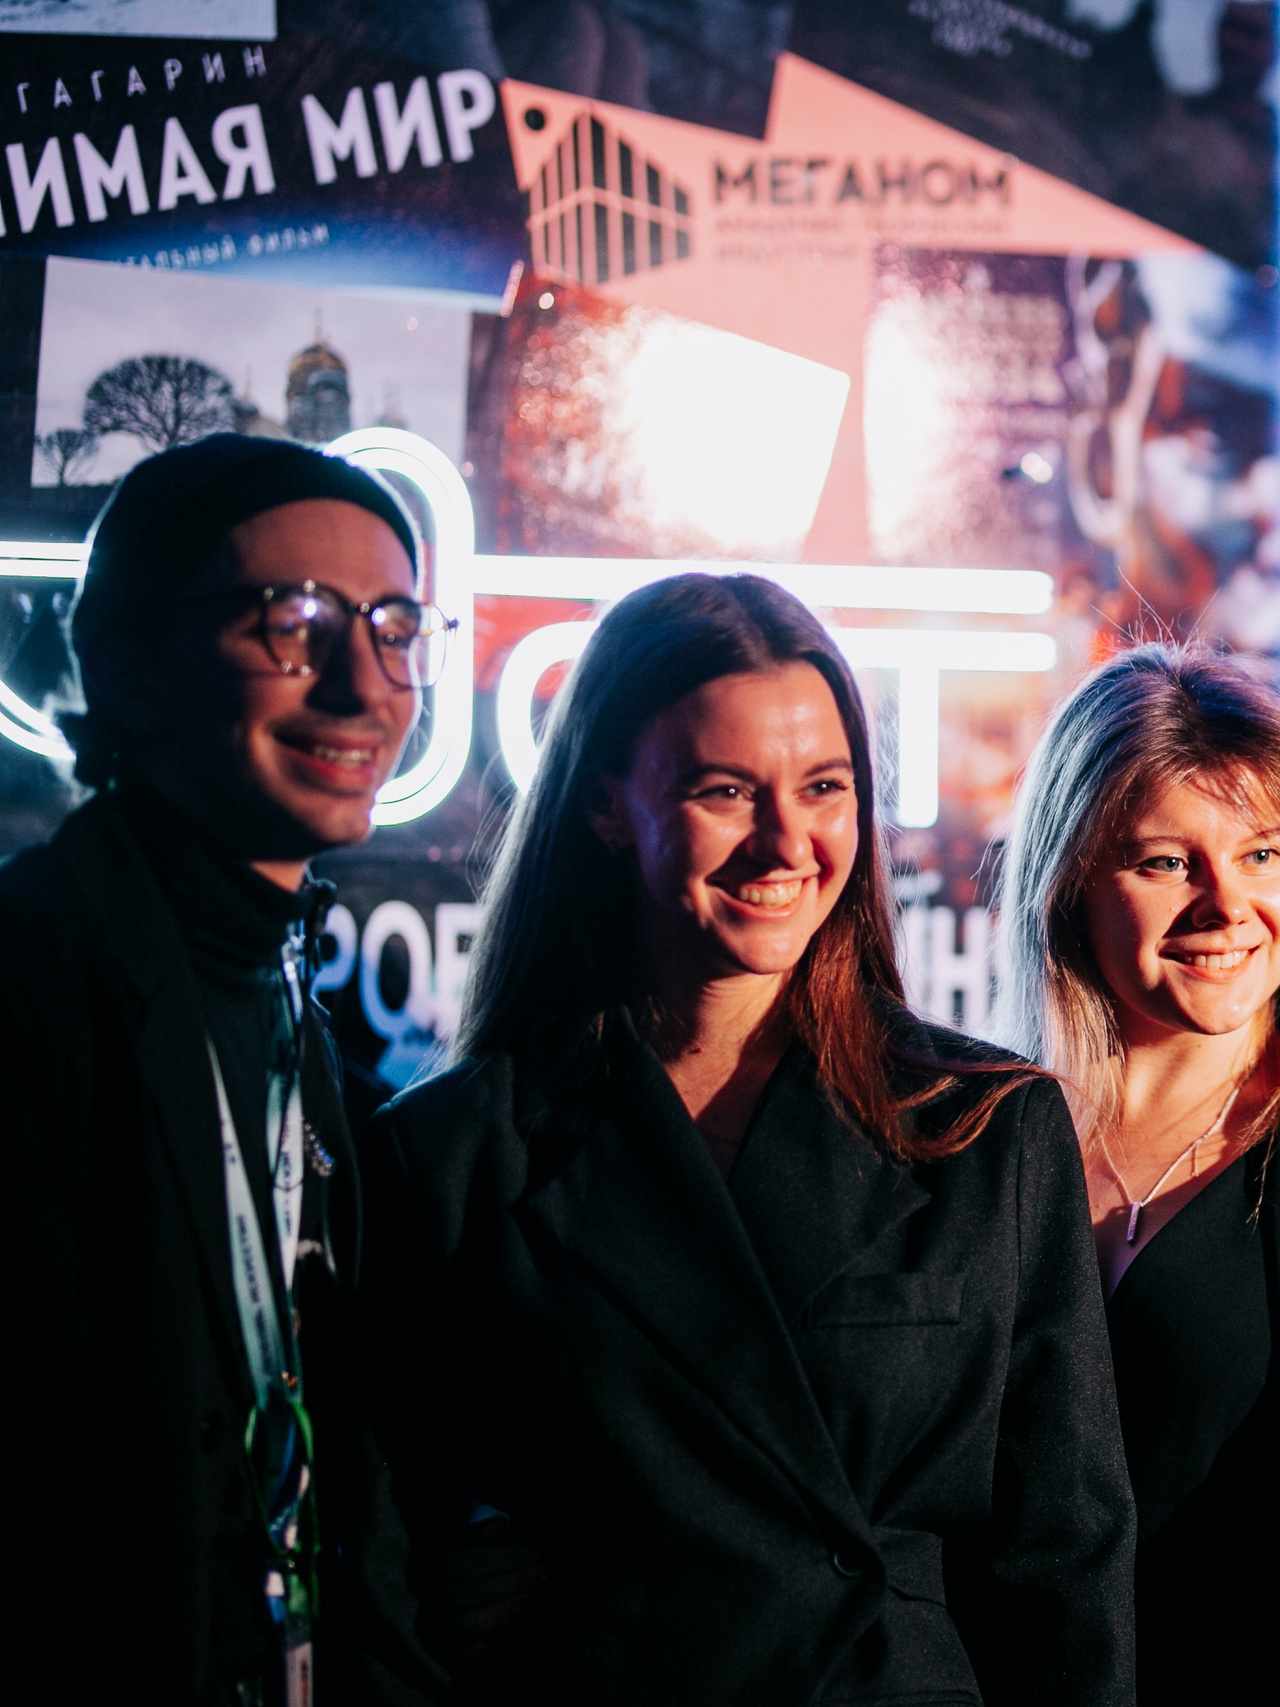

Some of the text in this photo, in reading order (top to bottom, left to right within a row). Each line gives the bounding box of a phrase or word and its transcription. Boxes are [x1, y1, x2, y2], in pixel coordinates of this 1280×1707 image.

[17, 45, 266, 113] ГАГАРИН
[0, 69, 496, 238] ИМАЯ МИР
[712, 156, 1012, 206] МЕГАНОМ
[117, 234, 237, 271] ТАЛЬНЫЙ
